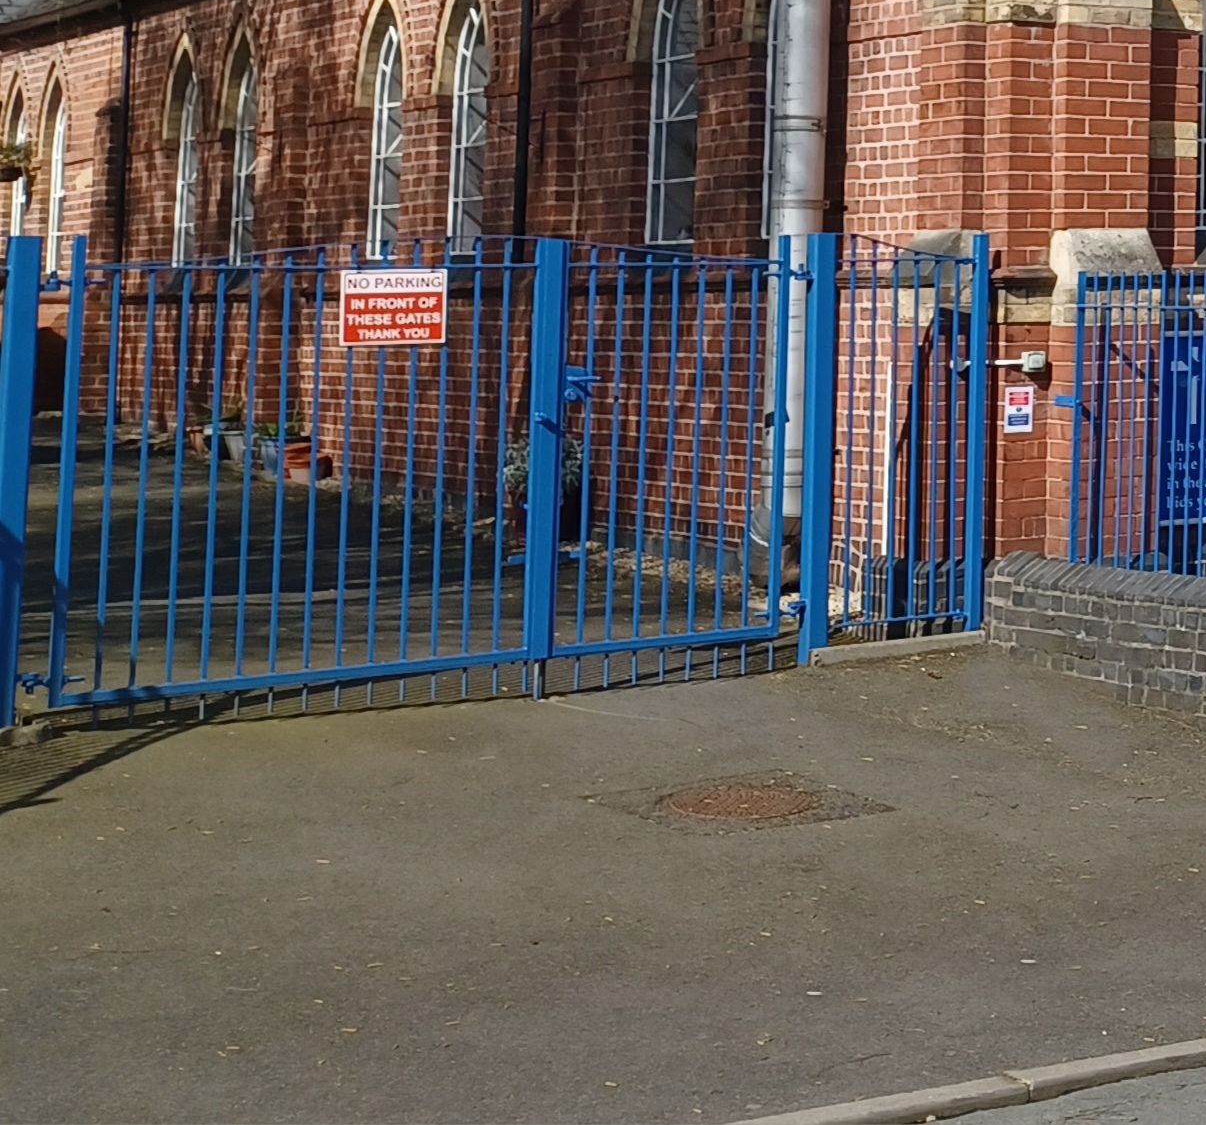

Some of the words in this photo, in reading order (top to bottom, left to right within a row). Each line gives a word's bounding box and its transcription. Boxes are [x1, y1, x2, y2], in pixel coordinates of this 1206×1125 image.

[348, 278, 369, 289] NO
[375, 277, 442, 288] PARKING
[351, 299, 365, 310] IN
[368, 298, 416, 309] FRONT
[418, 297, 438, 308] OF
[347, 314, 392, 326] THESE
[395, 312, 441, 325] GATES
[357, 329, 400, 340] THANK
[403, 328, 430, 338] YOU
